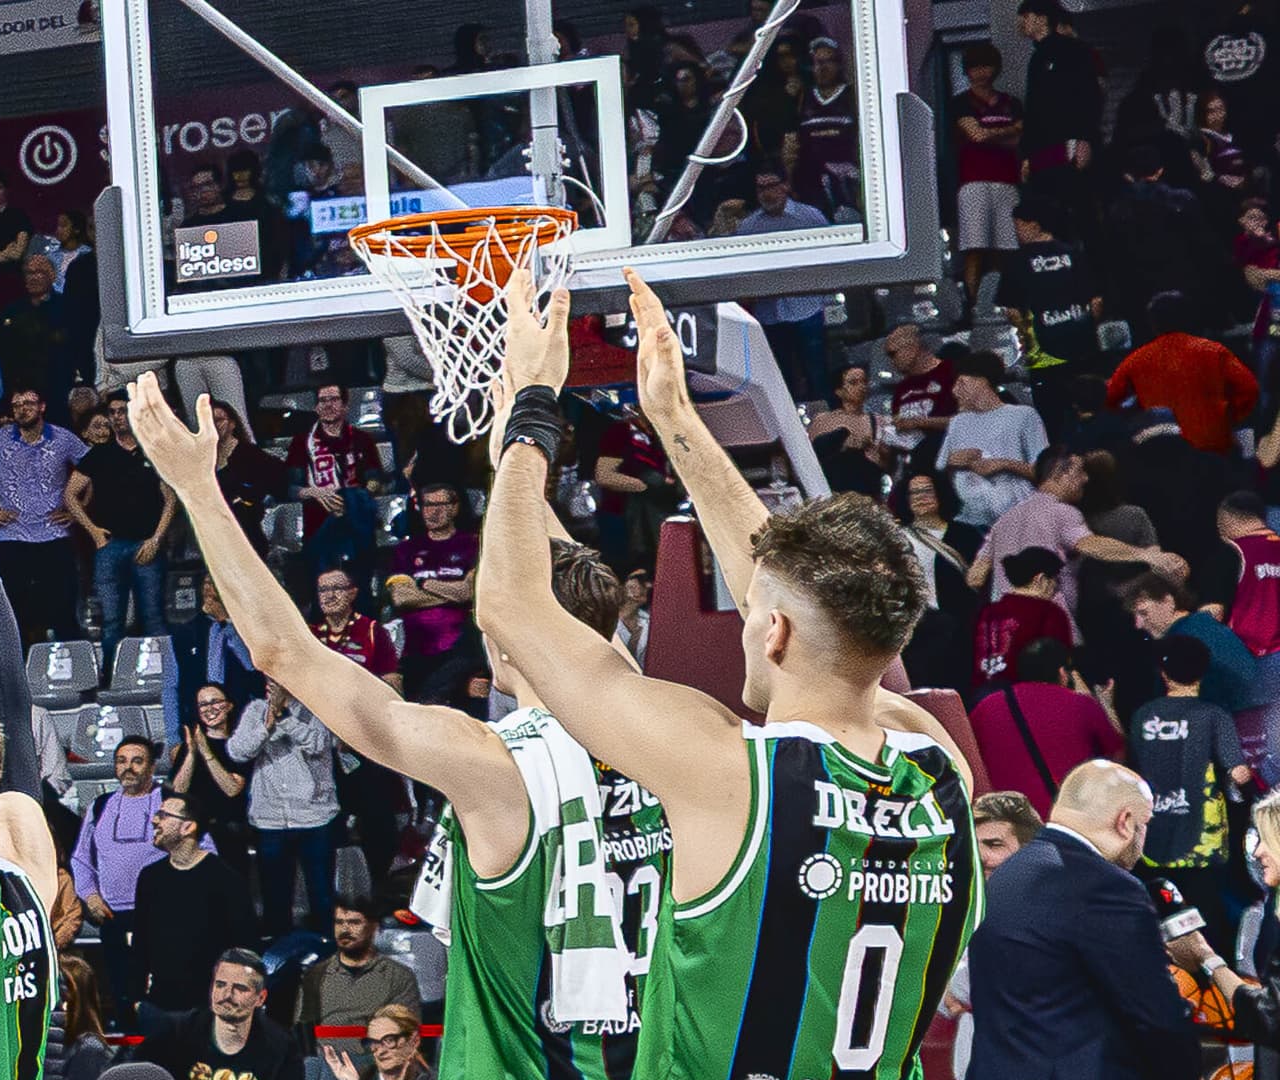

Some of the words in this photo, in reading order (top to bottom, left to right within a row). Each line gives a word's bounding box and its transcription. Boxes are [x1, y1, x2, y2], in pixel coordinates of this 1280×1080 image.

[39, 15, 68, 31] DEL
[178, 241, 216, 263] liga
[180, 255, 258, 276] endesa
[847, 871, 954, 904] PROBITAS
[831, 924, 905, 1072] 0
